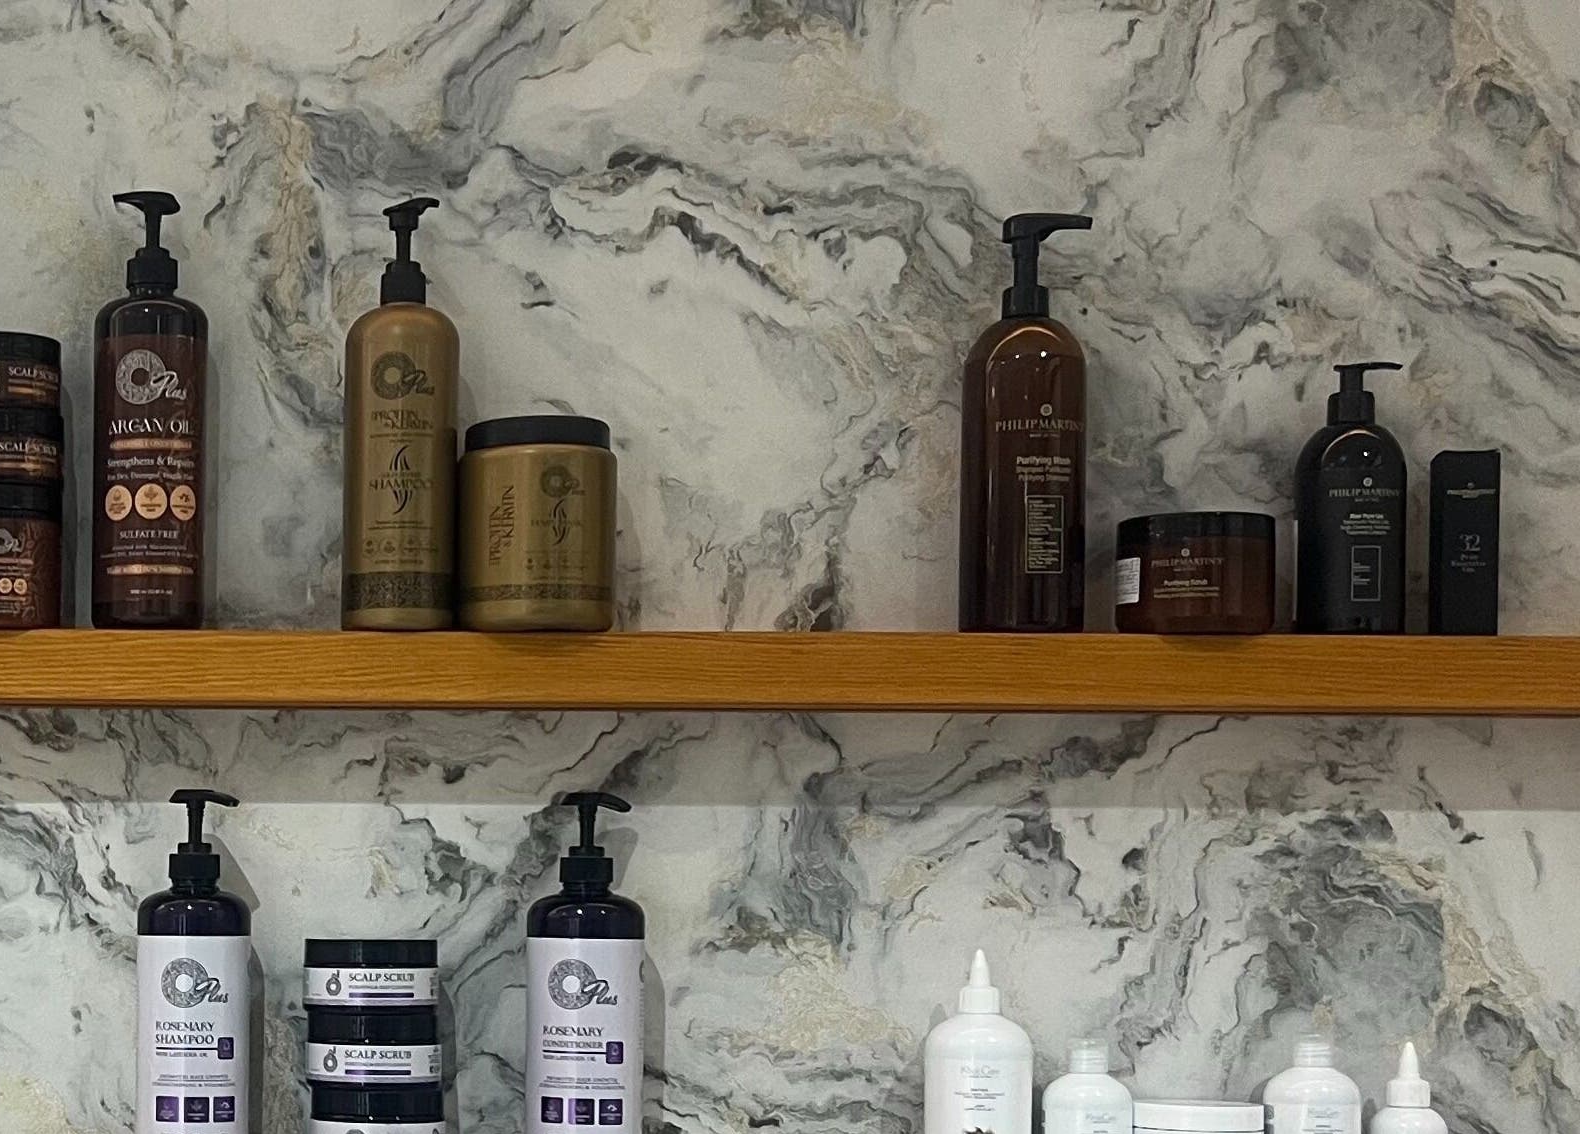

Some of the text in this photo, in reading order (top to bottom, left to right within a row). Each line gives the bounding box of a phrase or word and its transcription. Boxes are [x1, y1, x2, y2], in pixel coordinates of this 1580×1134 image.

[108, 418, 194, 435] ARGAN OIL
[348, 973, 415, 982] SCALP SCRUB
[155, 1020, 215, 1032] ROSEMARY
[542, 1025, 604, 1037] ROSEMARY
[155, 1034, 215, 1045] SHAMPOO
[542, 1039, 604, 1049] CONDITIONER
[344, 1049, 412, 1060] SCALP SCRUB
